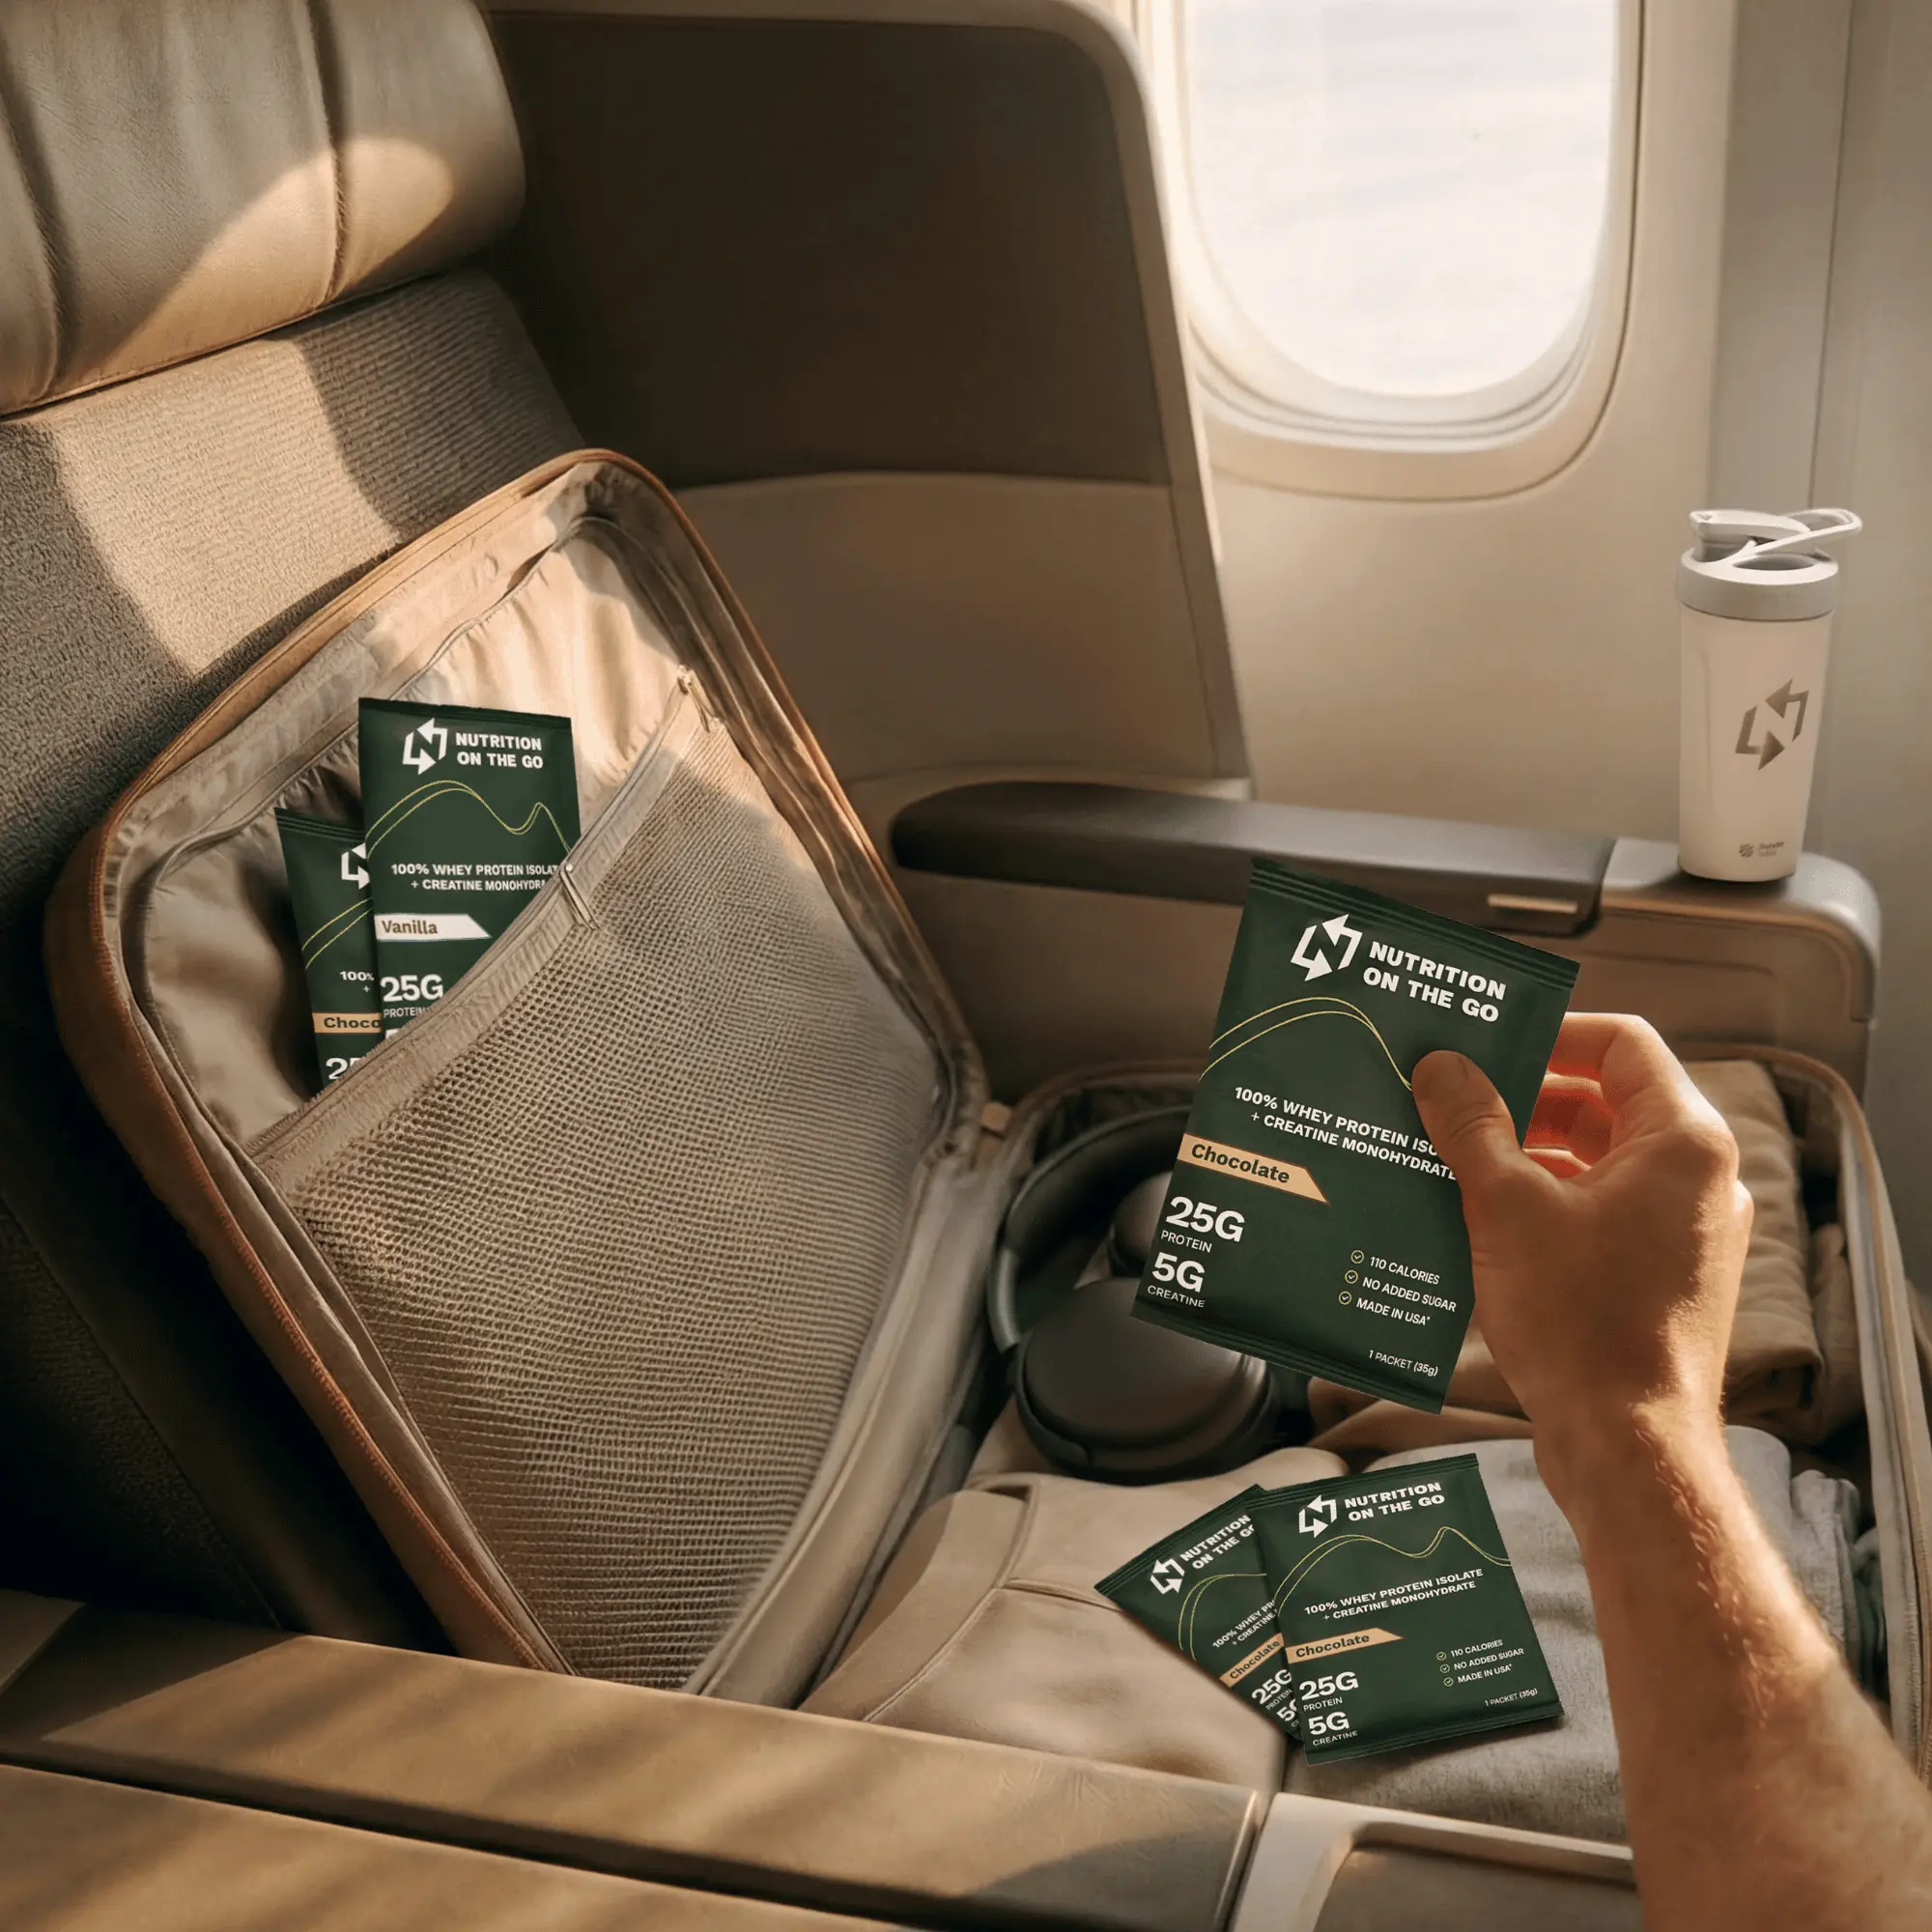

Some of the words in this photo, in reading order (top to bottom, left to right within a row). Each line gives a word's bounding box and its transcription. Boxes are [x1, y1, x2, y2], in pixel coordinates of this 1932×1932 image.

[455, 732, 542, 751] NUTRITION
[457, 752, 482, 765] ON
[486, 753, 517, 767] THE
[522, 754, 543, 769] GO
[391, 864, 430, 875] 100%
[433, 864, 472, 876] WHEY
[475, 865, 524, 875] PROTEIN
[422, 879, 482, 891] CREATINE
[382, 920, 438, 934] Vanilla
[340, 971, 374, 981] 100%
[1369, 941, 1506, 1001] NUTRITION
[380, 974, 443, 1002] 25G
[1363, 967, 1400, 992] ON
[1407, 980, 1454, 1009] THE
[1462, 998, 1499, 1022] GO
[1235, 1087, 1278, 1110] 100%
[1283, 1099, 1333, 1125] WHEY
[1335, 1117, 1408, 1148] PROTEIN
[1264, 1115, 1340, 1146] CREATINE
[1191, 1144, 1290, 1183] Chocolate
[1165, 1196, 1245, 1242] 25G
[1161, 1230, 1212, 1253] PROTEIN
[1151, 1252, 1206, 1293] 5G
[1370, 1257, 1387, 1269] 110
[1388, 1263, 1440, 1285] CALORIES
[1148, 1285, 1206, 1308] CREATINE
[1356, 1297, 1390, 1316] MADE
[1391, 1307, 1404, 1320] IN
[1362, 1277, 1380, 1290] NO
[1381, 1283, 1420, 1302] ADDED
[1422, 1294, 1457, 1313] SUGAR
[1375, 1352, 1412, 1369] PACKET
[1413, 1361, 1438, 1377] (35g)
[1344, 1482, 1442, 1509] NUTRITION
[1349, 1508, 1374, 1521] ON
[1378, 1500, 1413, 1515] THE
[1418, 1494, 1445, 1507] GO
[1179, 1515, 1251, 1562] NUTRITION
[1192, 1553, 1214, 1569] ON
[1212, 1536, 1240, 1554] THE
[1304, 1601, 1338, 1615] 100%
[1340, 1592, 1377, 1607] WHEY
[1379, 1579, 1434, 1599] PROTEIN
[1435, 1568, 1484, 1586] ISOLATE
[1333, 1601, 1389, 1619] CREATINE
[1391, 1580, 1476, 1606] MONOHYDRATE
[1212, 1630, 1237, 1648] 100%
[1235, 1610, 1263, 1631] WHEY
[1237, 1612, 1276, 1641] CREATINE
[1295, 1634, 1370, 1658] Chocolate
[1450, 1648, 1463, 1658] 110
[1464, 1639, 1503, 1654] CALORIES
[1454, 1662, 1467, 1670] NO
[1468, 1654, 1497, 1666] ADDED
[1498, 1648, 1524, 1661] SUGAR
[1251, 1669, 1293, 1705] 25G
[1298, 1671, 1359, 1700] 25G
[1457, 1671, 1483, 1683] MADE
[1303, 1696, 1343, 1712] PROTEIN
[1490, 1692, 1518, 1705] PACKET
[1519, 1688, 1538, 1699] (35g)
[1308, 1711, 1350, 1735] 5G
[1312, 1730, 1358, 1747] CREATINE
